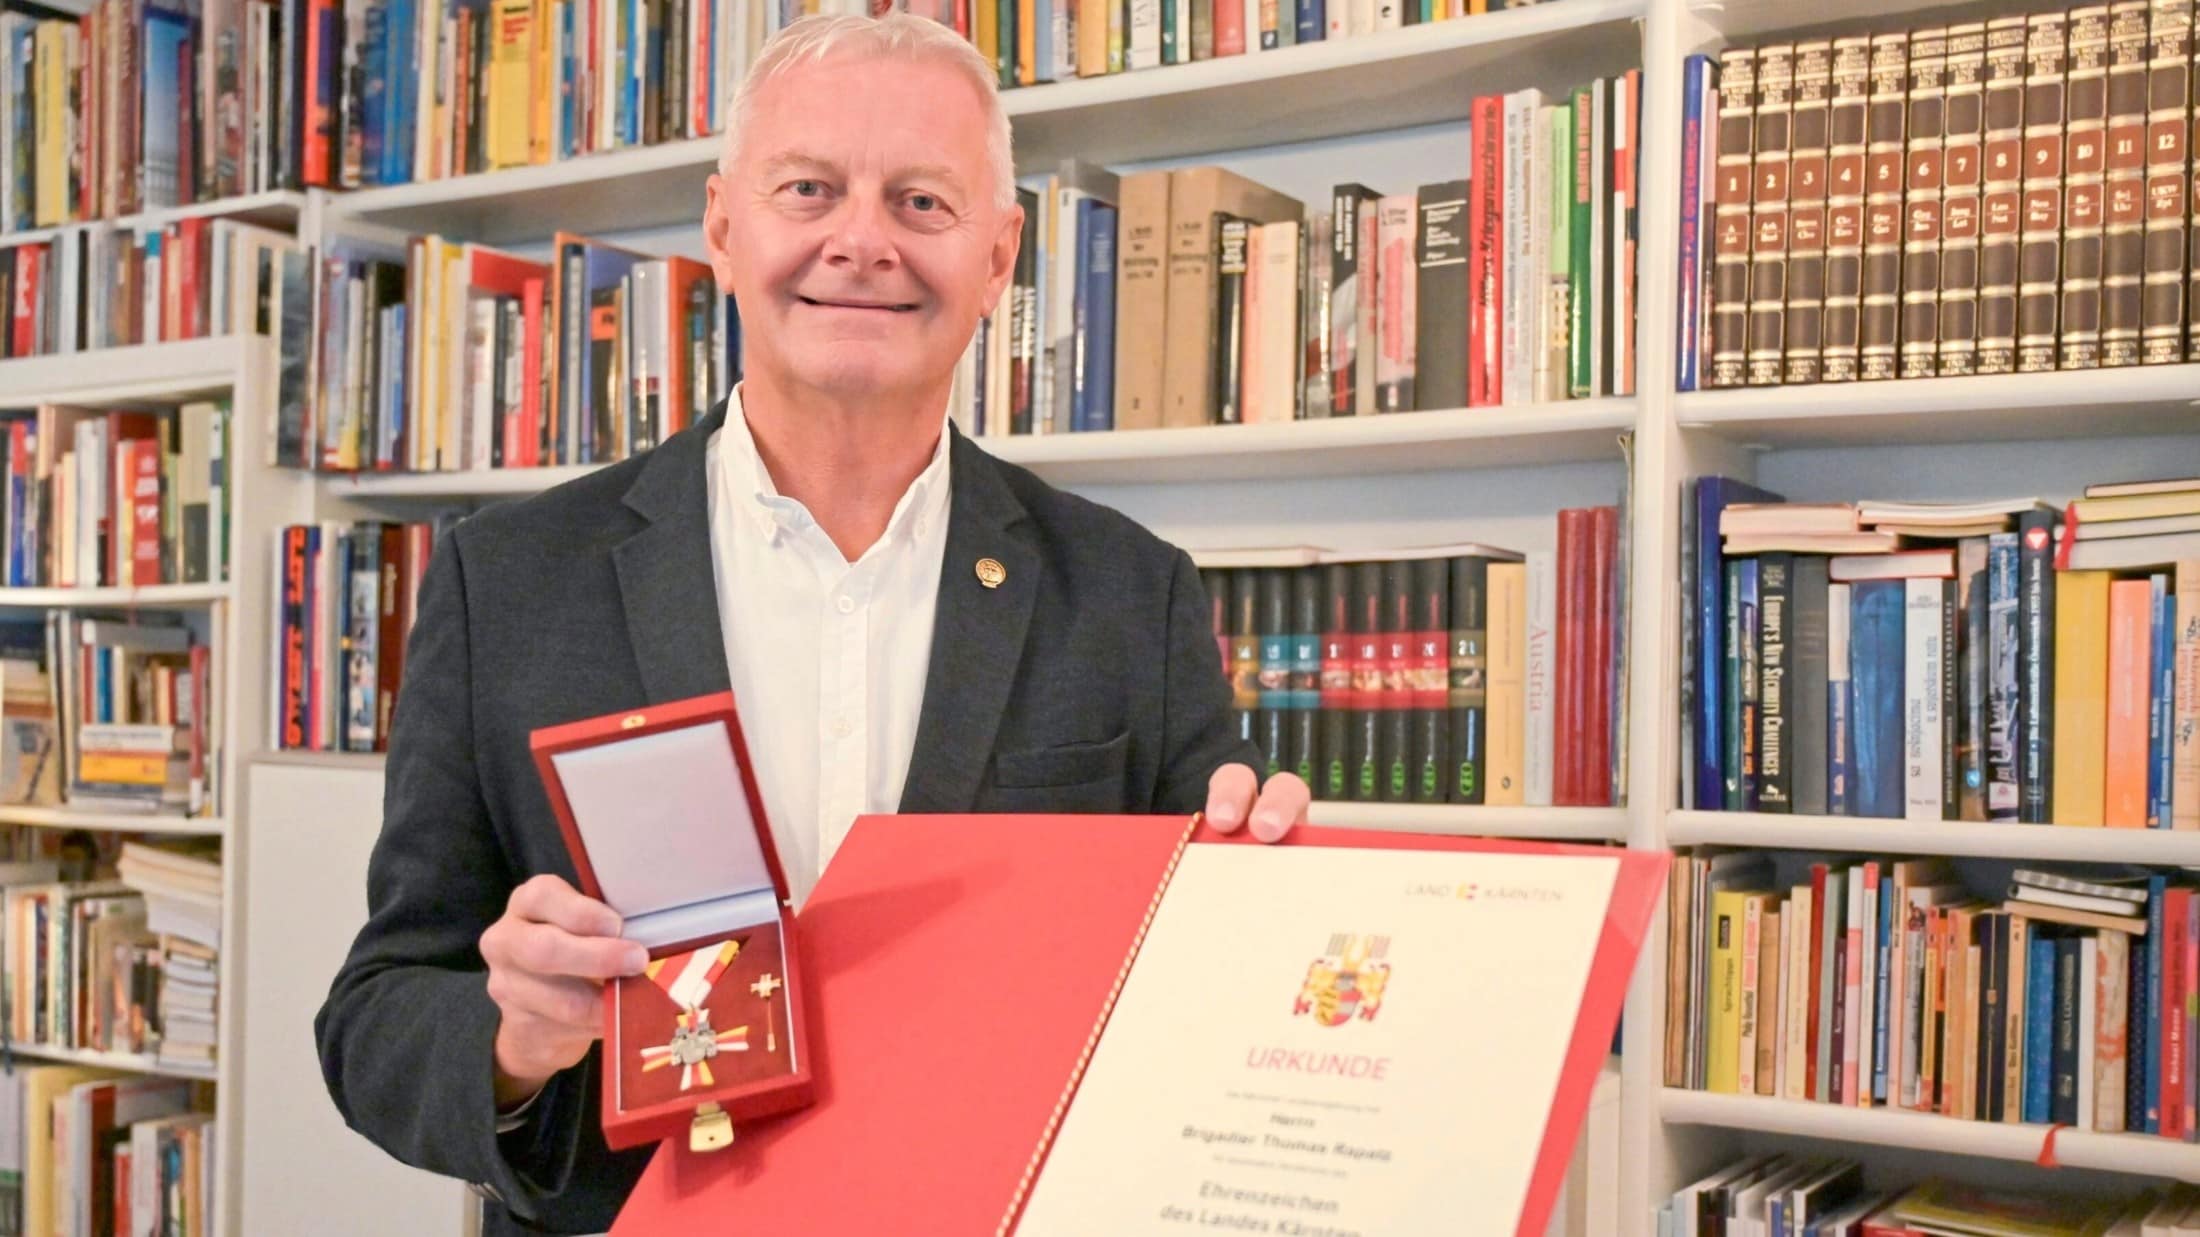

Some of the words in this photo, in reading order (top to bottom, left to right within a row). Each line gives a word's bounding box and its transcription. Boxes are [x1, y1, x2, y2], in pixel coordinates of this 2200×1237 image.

[2117, 139, 2133, 155] 11
[2158, 133, 2175, 150] 12
[1996, 152, 2007, 167] 8
[2036, 149, 2048, 165] 9
[2076, 144, 2094, 159] 10
[1879, 164, 1889, 180] 5
[1918, 162, 1929, 176] 6
[1957, 157, 1967, 172] 7
[1765, 173, 1776, 189] 2
[1802, 171, 1814, 185] 3
[1840, 168, 1852, 181] 4
[1729, 176, 1737, 192] 1
[1764, 596, 1784, 642] EUROPE'S
[1459, 640, 1477, 656] 21
[1764, 644, 1784, 665] NEW
[1530, 624, 1548, 712] Austria
[1764, 667, 1784, 715] SECURITY
[1405, 883, 1449, 897] LAND
[2170, 1007, 2181, 1042] Moore
[1246, 1046, 1392, 1081] URKUNDE
[2168, 1042, 2180, 1084] Michael
[1181, 1125, 1256, 1145] Brigadier
[1262, 1132, 1327, 1153] Thomas
[1198, 1180, 1341, 1214] Ehrenzeichen
[1159, 1203, 1194, 1223] des
[1198, 1209, 1270, 1233] Landes
[1275, 1215, 1362, 1237] Kärnten
